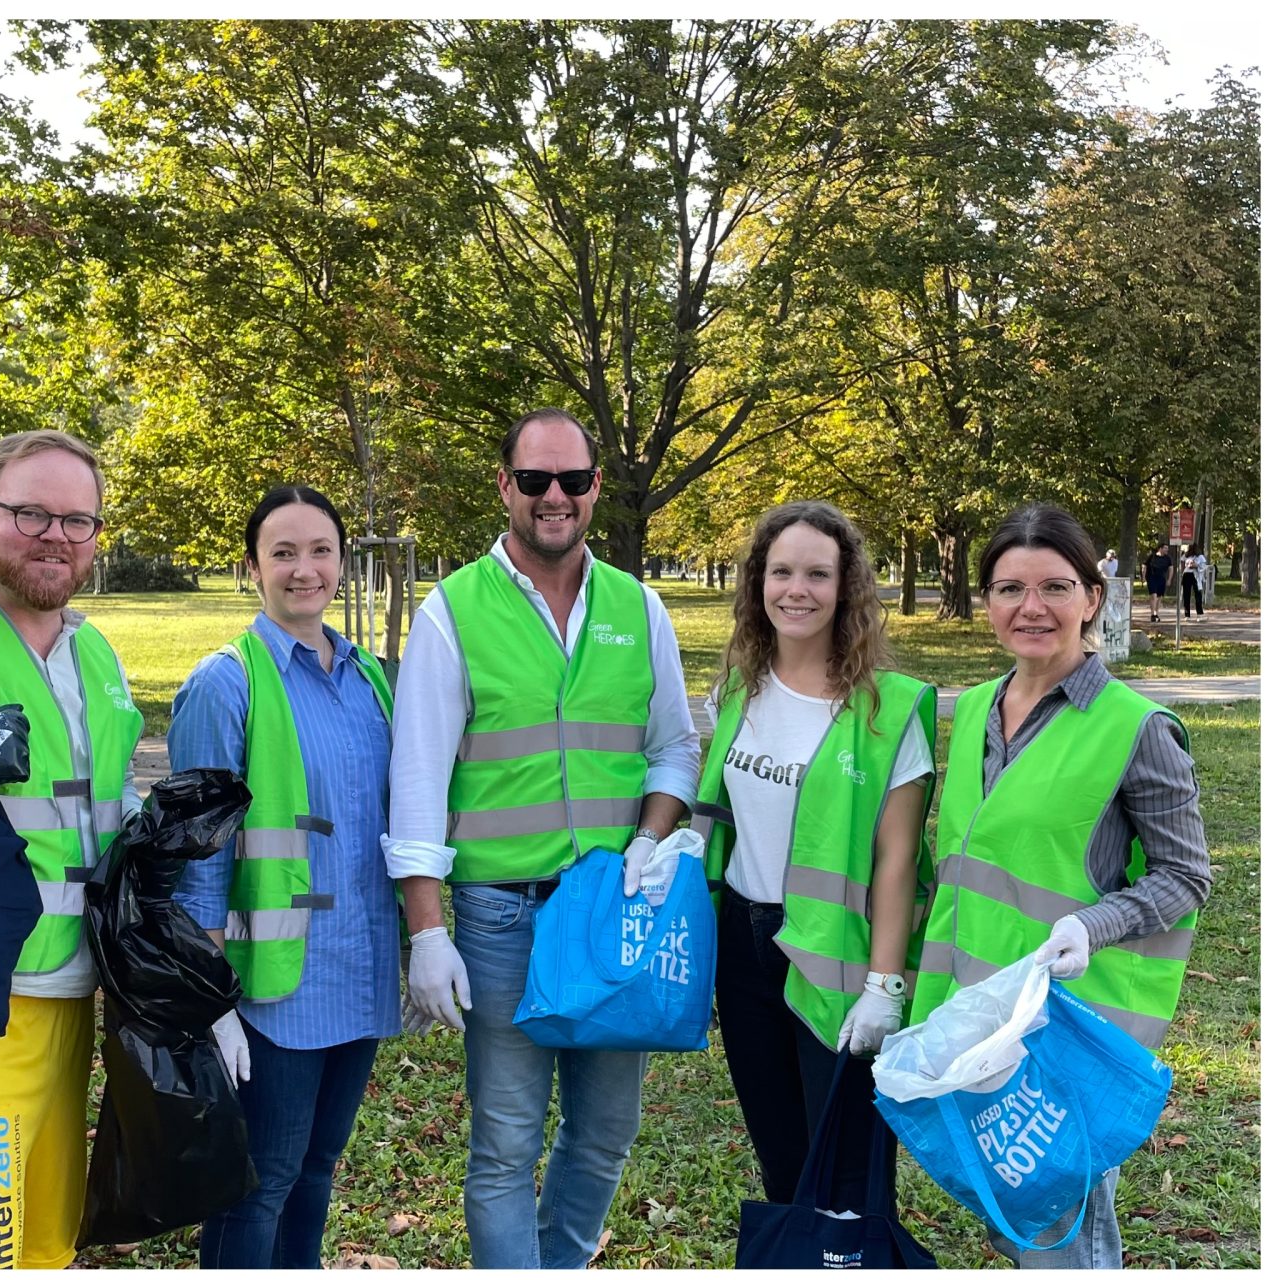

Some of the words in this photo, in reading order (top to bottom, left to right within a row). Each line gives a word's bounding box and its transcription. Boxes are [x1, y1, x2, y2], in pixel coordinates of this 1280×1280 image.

[680, 915, 688, 929] A
[970, 1119, 977, 1133] I
[976, 1103, 1002, 1129] USED
[992, 1094, 1068, 1189] BOTTLE
[15, 1186, 23, 1231] waste
